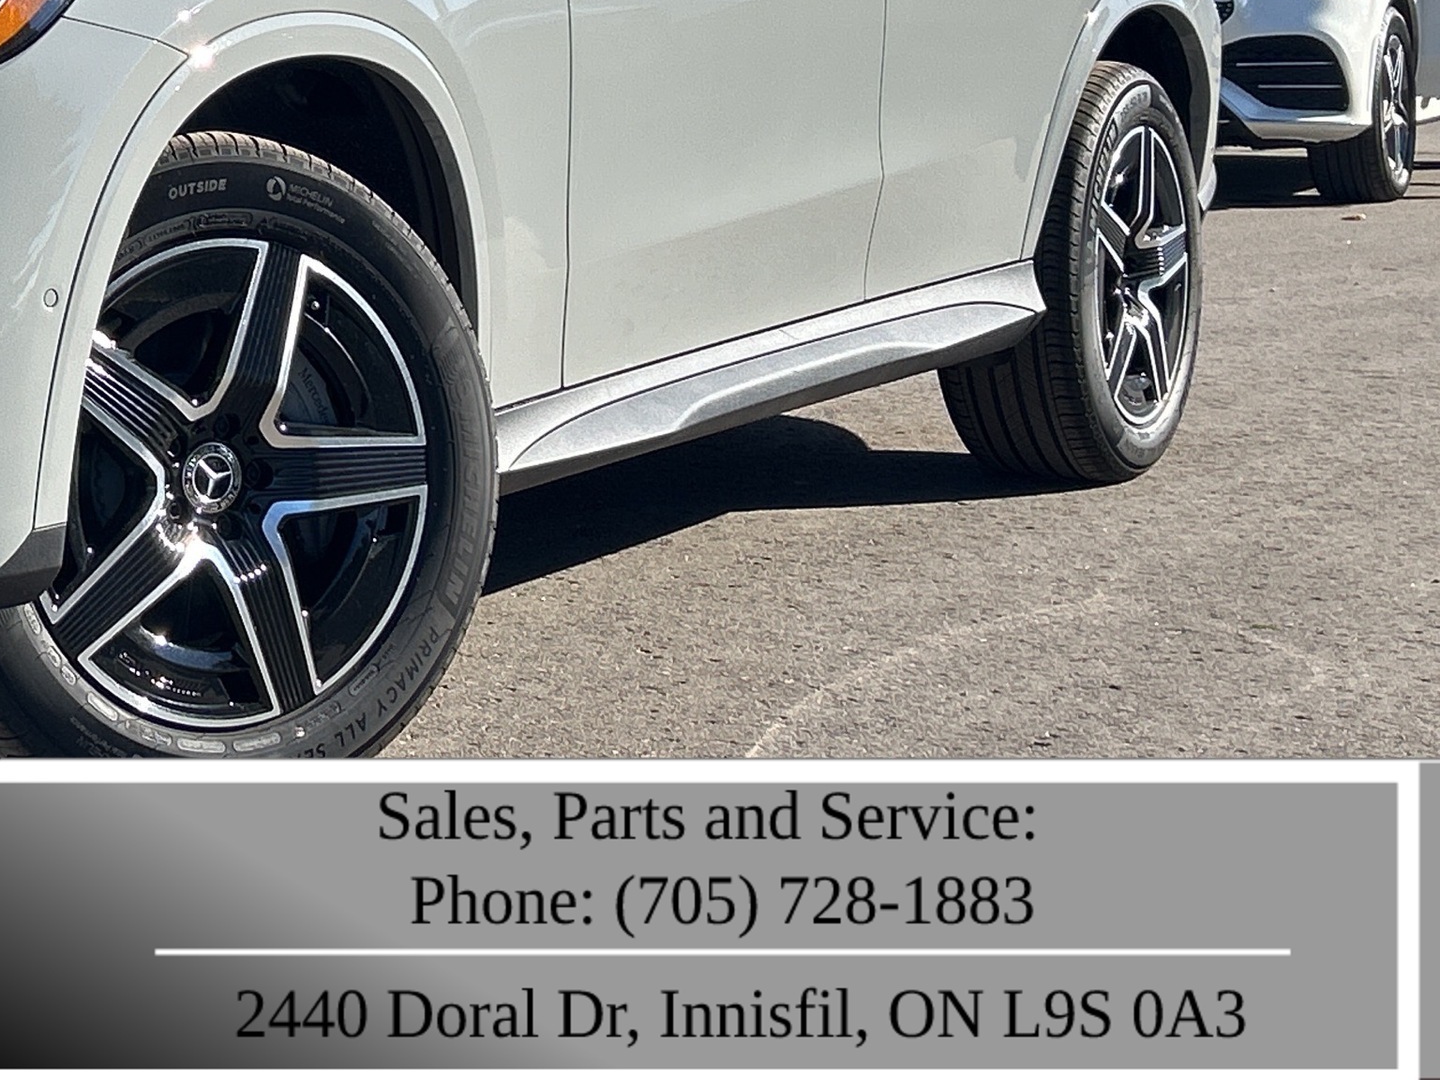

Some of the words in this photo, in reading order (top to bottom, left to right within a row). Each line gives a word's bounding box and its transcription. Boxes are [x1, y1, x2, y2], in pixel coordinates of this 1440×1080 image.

[168, 179, 228, 200] OUTSIDE
[377, 626, 440, 718] PRIMACY
[334, 712, 367, 748] ALL
